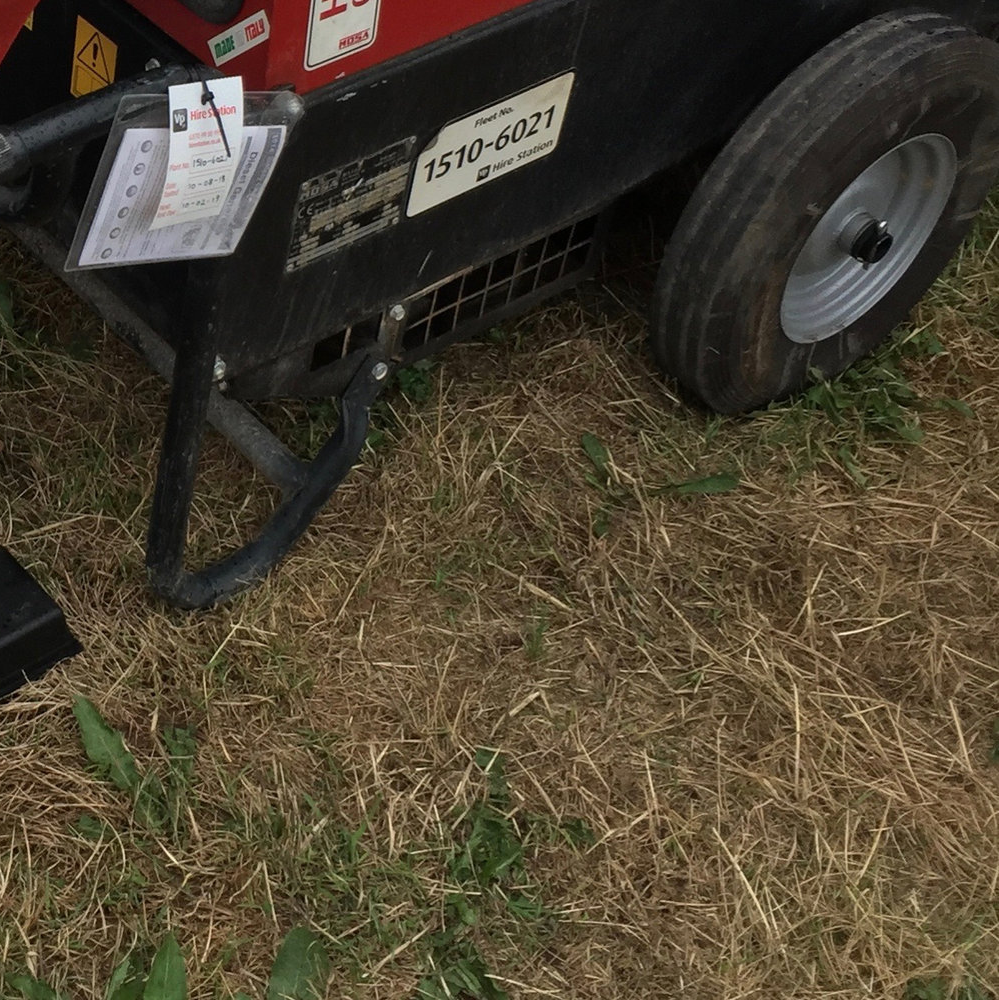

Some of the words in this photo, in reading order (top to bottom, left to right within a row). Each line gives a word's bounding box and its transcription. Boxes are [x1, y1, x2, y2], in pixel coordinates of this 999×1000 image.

[190, 109, 207, 121] Hire
[474, 112, 498, 128] Fleet
[499, 106, 515, 116] No.
[424, 104, 557, 184] 1510-6021
[492, 158, 514, 173] Hire
[516, 139, 554, 162] Station
